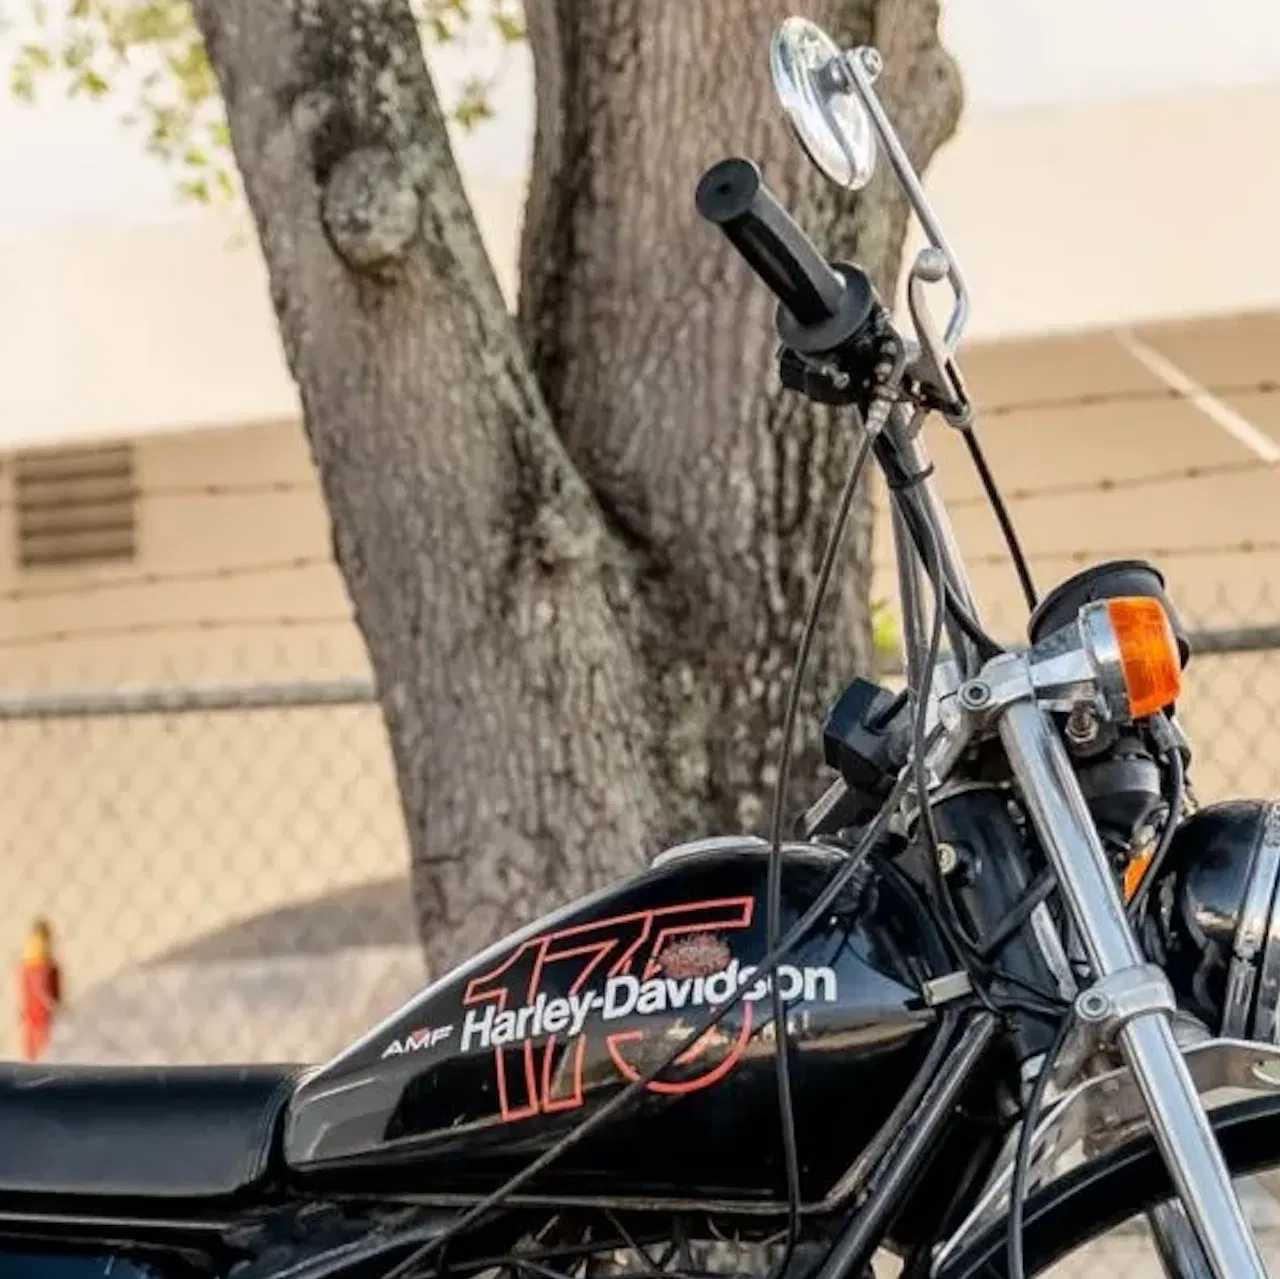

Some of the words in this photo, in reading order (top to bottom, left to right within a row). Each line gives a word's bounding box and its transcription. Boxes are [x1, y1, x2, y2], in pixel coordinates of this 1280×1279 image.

[380, 1024, 454, 1059] AMF
[460, 958, 838, 1052] Harley-Davidson
[463, 896, 755, 1122] 175
